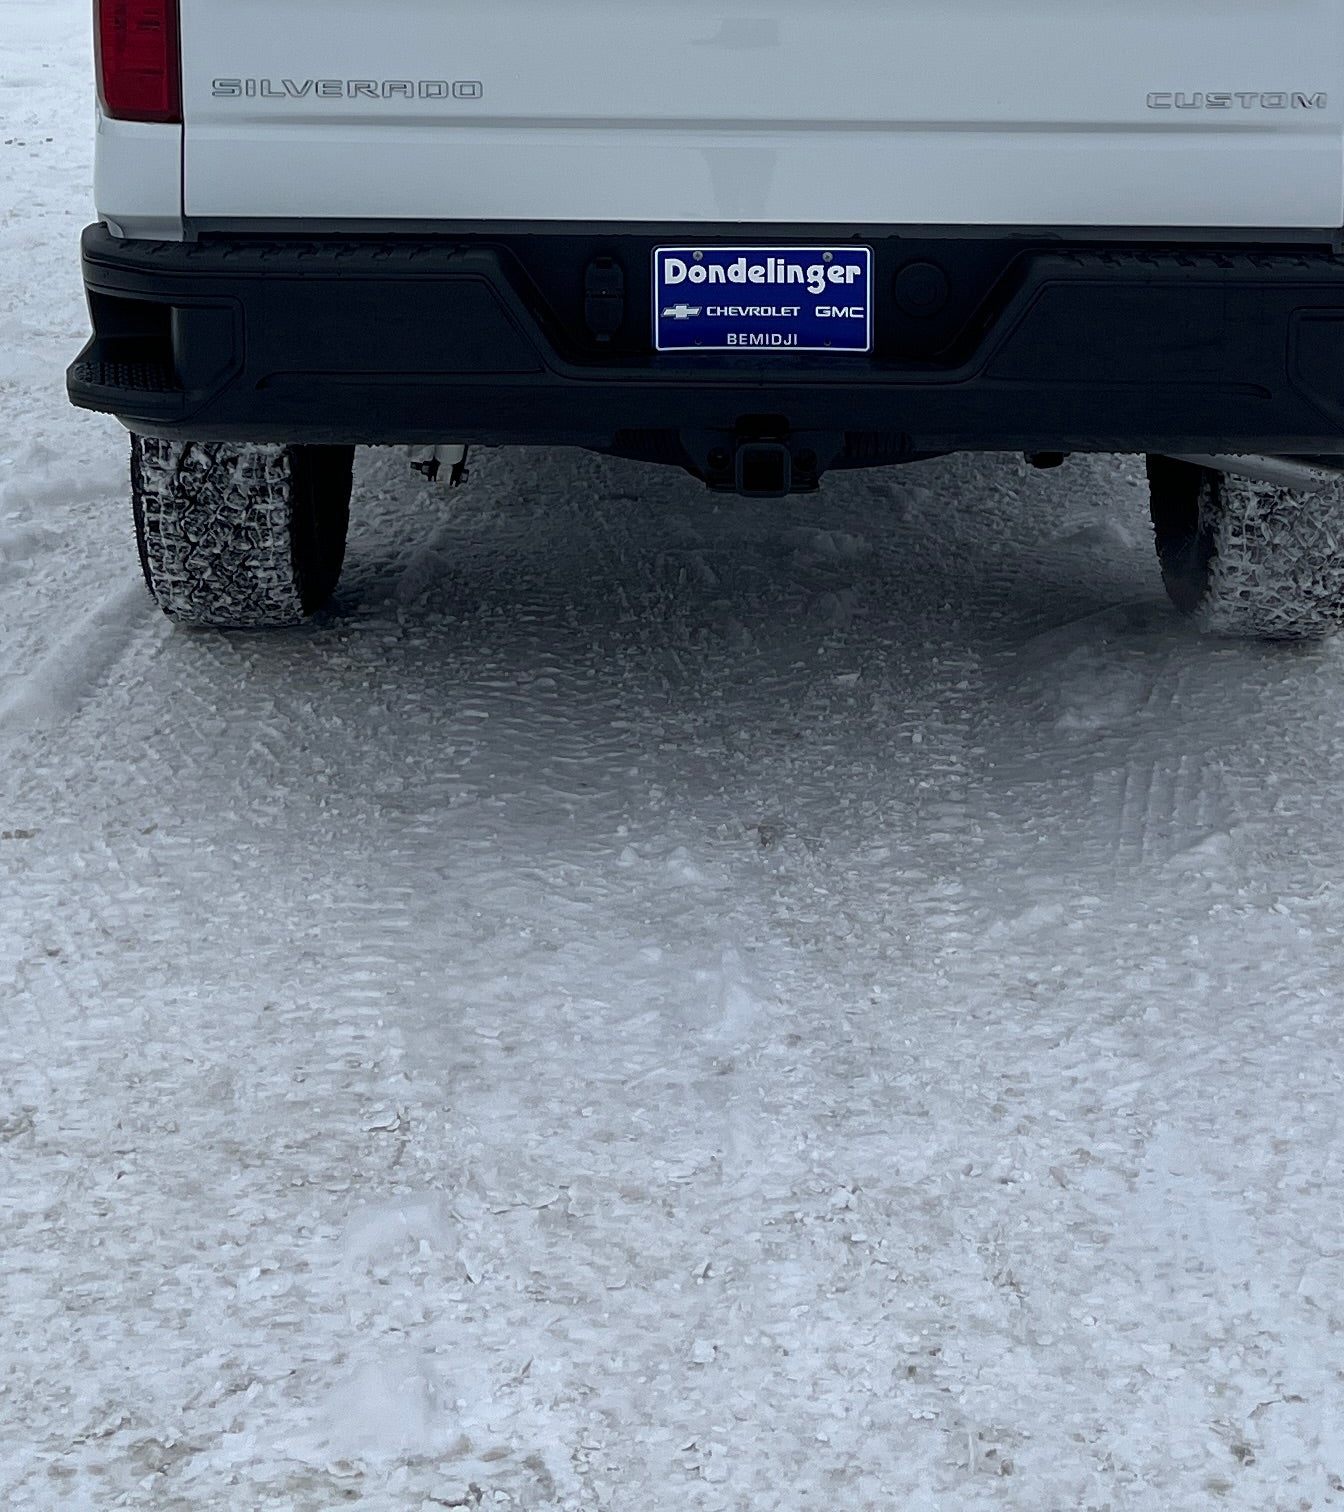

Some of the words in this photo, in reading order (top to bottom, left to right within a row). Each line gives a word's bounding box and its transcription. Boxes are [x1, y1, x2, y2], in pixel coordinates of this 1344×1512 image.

[212, 78, 483, 99] SILVERADO
[1146, 92, 1328, 109] CUSTOM
[664, 257, 861, 295] Dondelinger
[706, 306, 800, 317] CHEVROLET
[815, 306, 864, 318] GMC
[727, 333, 798, 346] BEMIDJI
